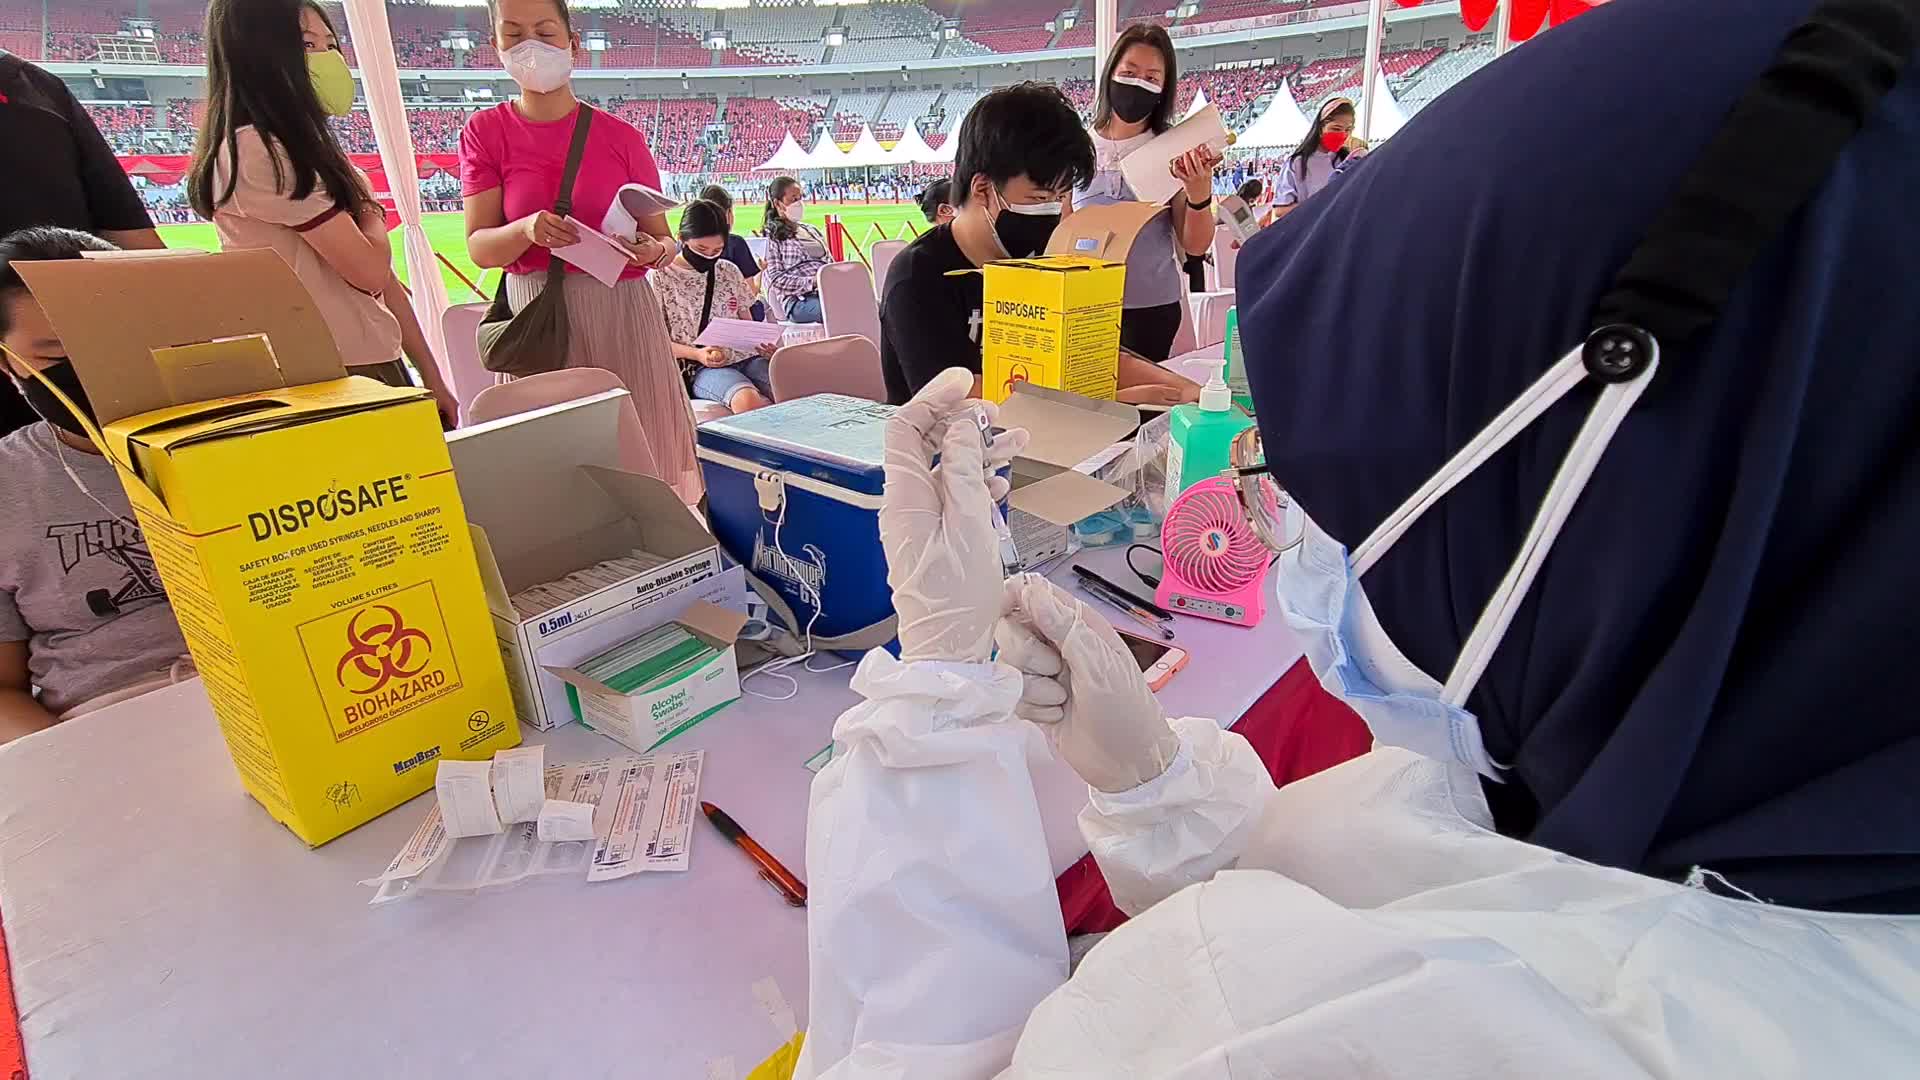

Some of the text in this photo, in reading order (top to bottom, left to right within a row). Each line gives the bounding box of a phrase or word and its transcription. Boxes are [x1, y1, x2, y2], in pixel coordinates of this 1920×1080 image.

[240, 557, 270, 572] SAFETY
[290, 546, 307, 558] FOR
[307, 540, 328, 552] USED
[368, 518, 399, 534] NEEDLES
[400, 514, 413, 525] AND
[414, 506, 441, 520] SHARPS
[636, 571, 684, 594] Auto-Disable
[684, 560, 711, 576] Syringe
[330, 592, 364, 609] VOLUME
[371, 582, 399, 597] LITRES
[538, 611, 573, 635] 0.5ml
[344, 669, 445, 725] BIOHAZARD
[651, 688, 686, 713] Alcohol
[652, 701, 684, 720] Swabs
